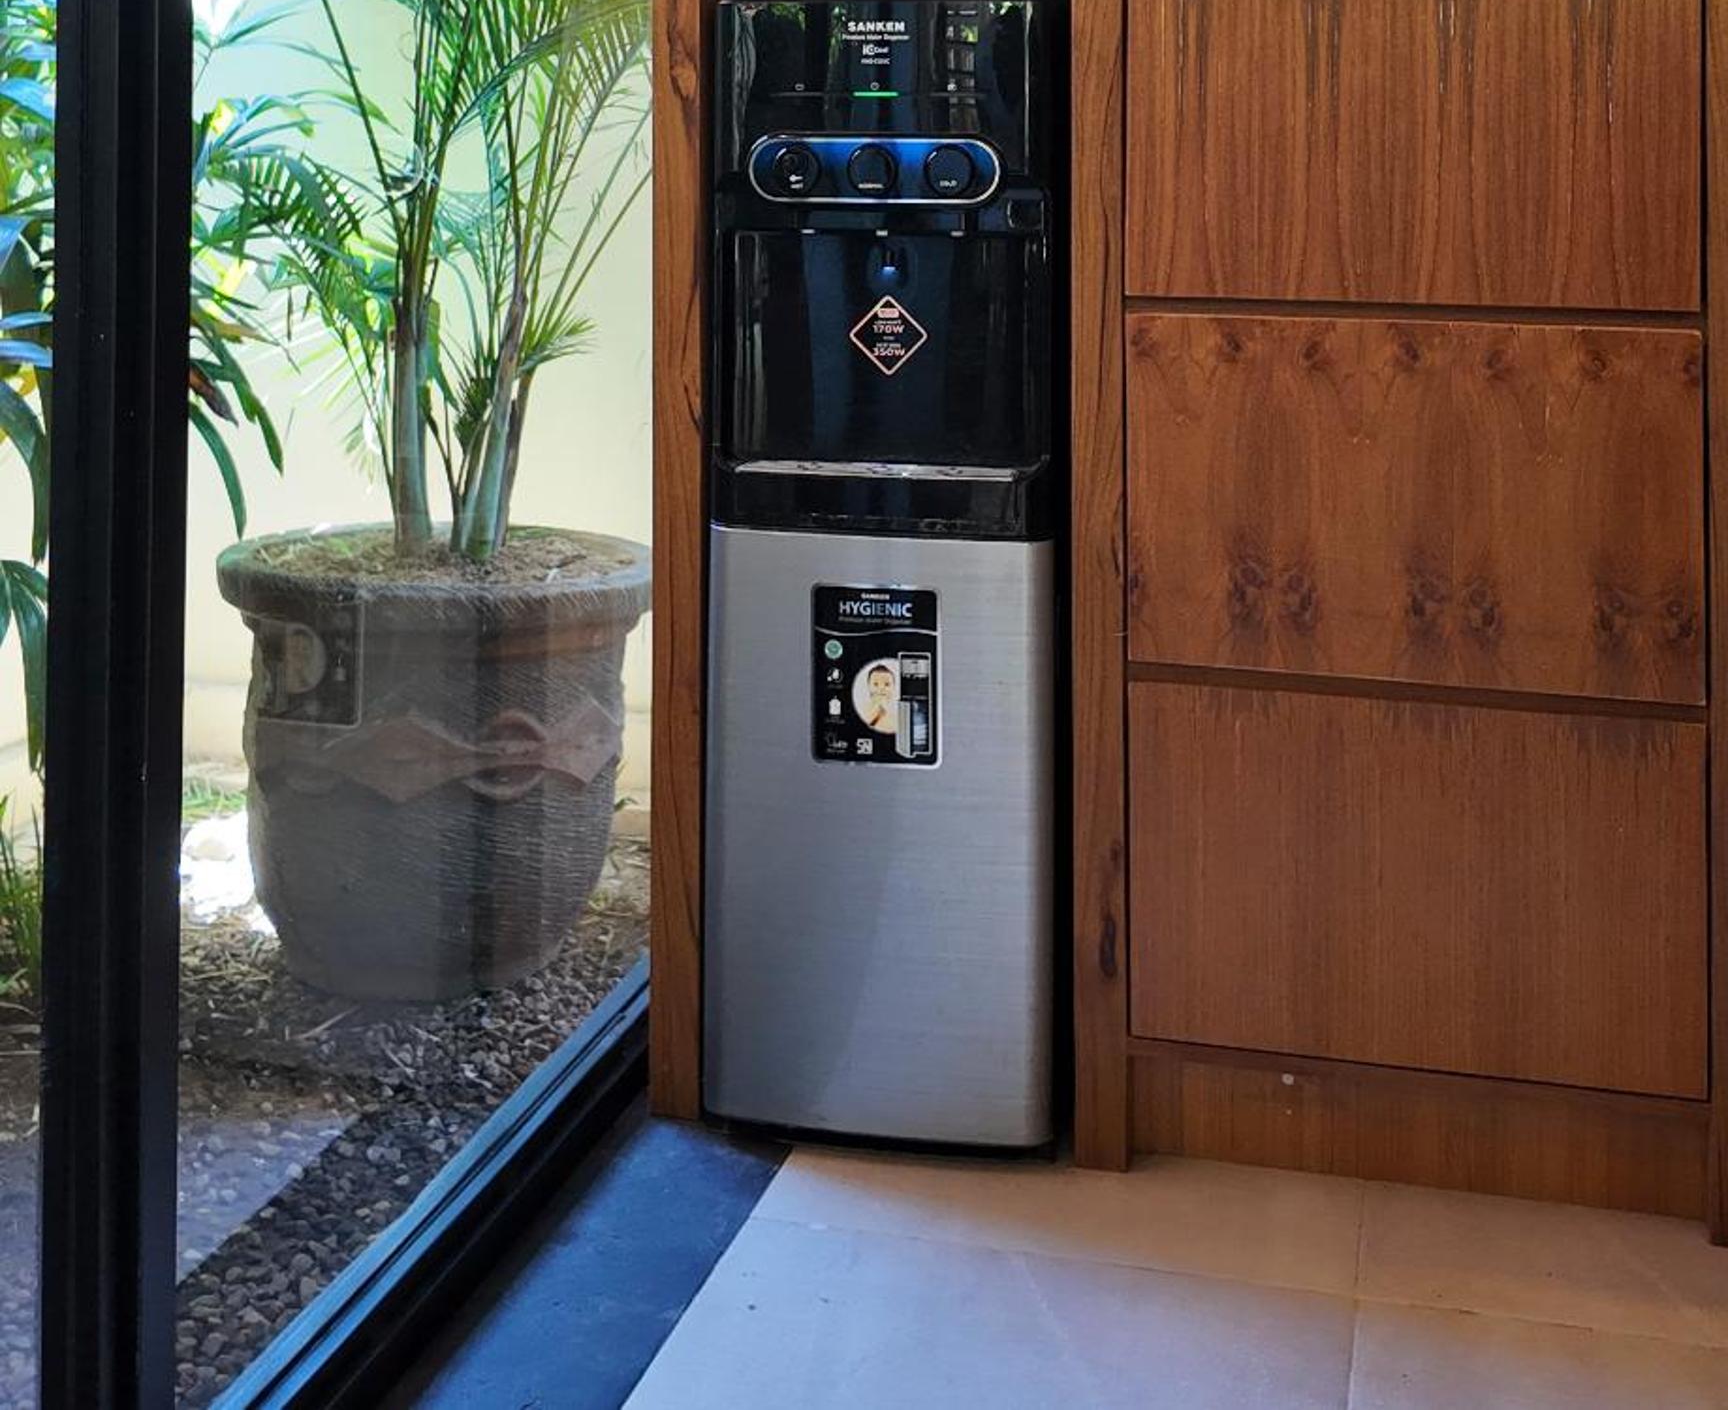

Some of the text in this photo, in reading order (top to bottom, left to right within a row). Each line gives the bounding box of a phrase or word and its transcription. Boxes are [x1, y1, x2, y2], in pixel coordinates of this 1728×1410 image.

[847, 21, 906, 32] SANKEN
[873, 324, 905, 334] 170W
[873, 347, 906, 357] 350W
[839, 601, 913, 617] HYGIENIC
